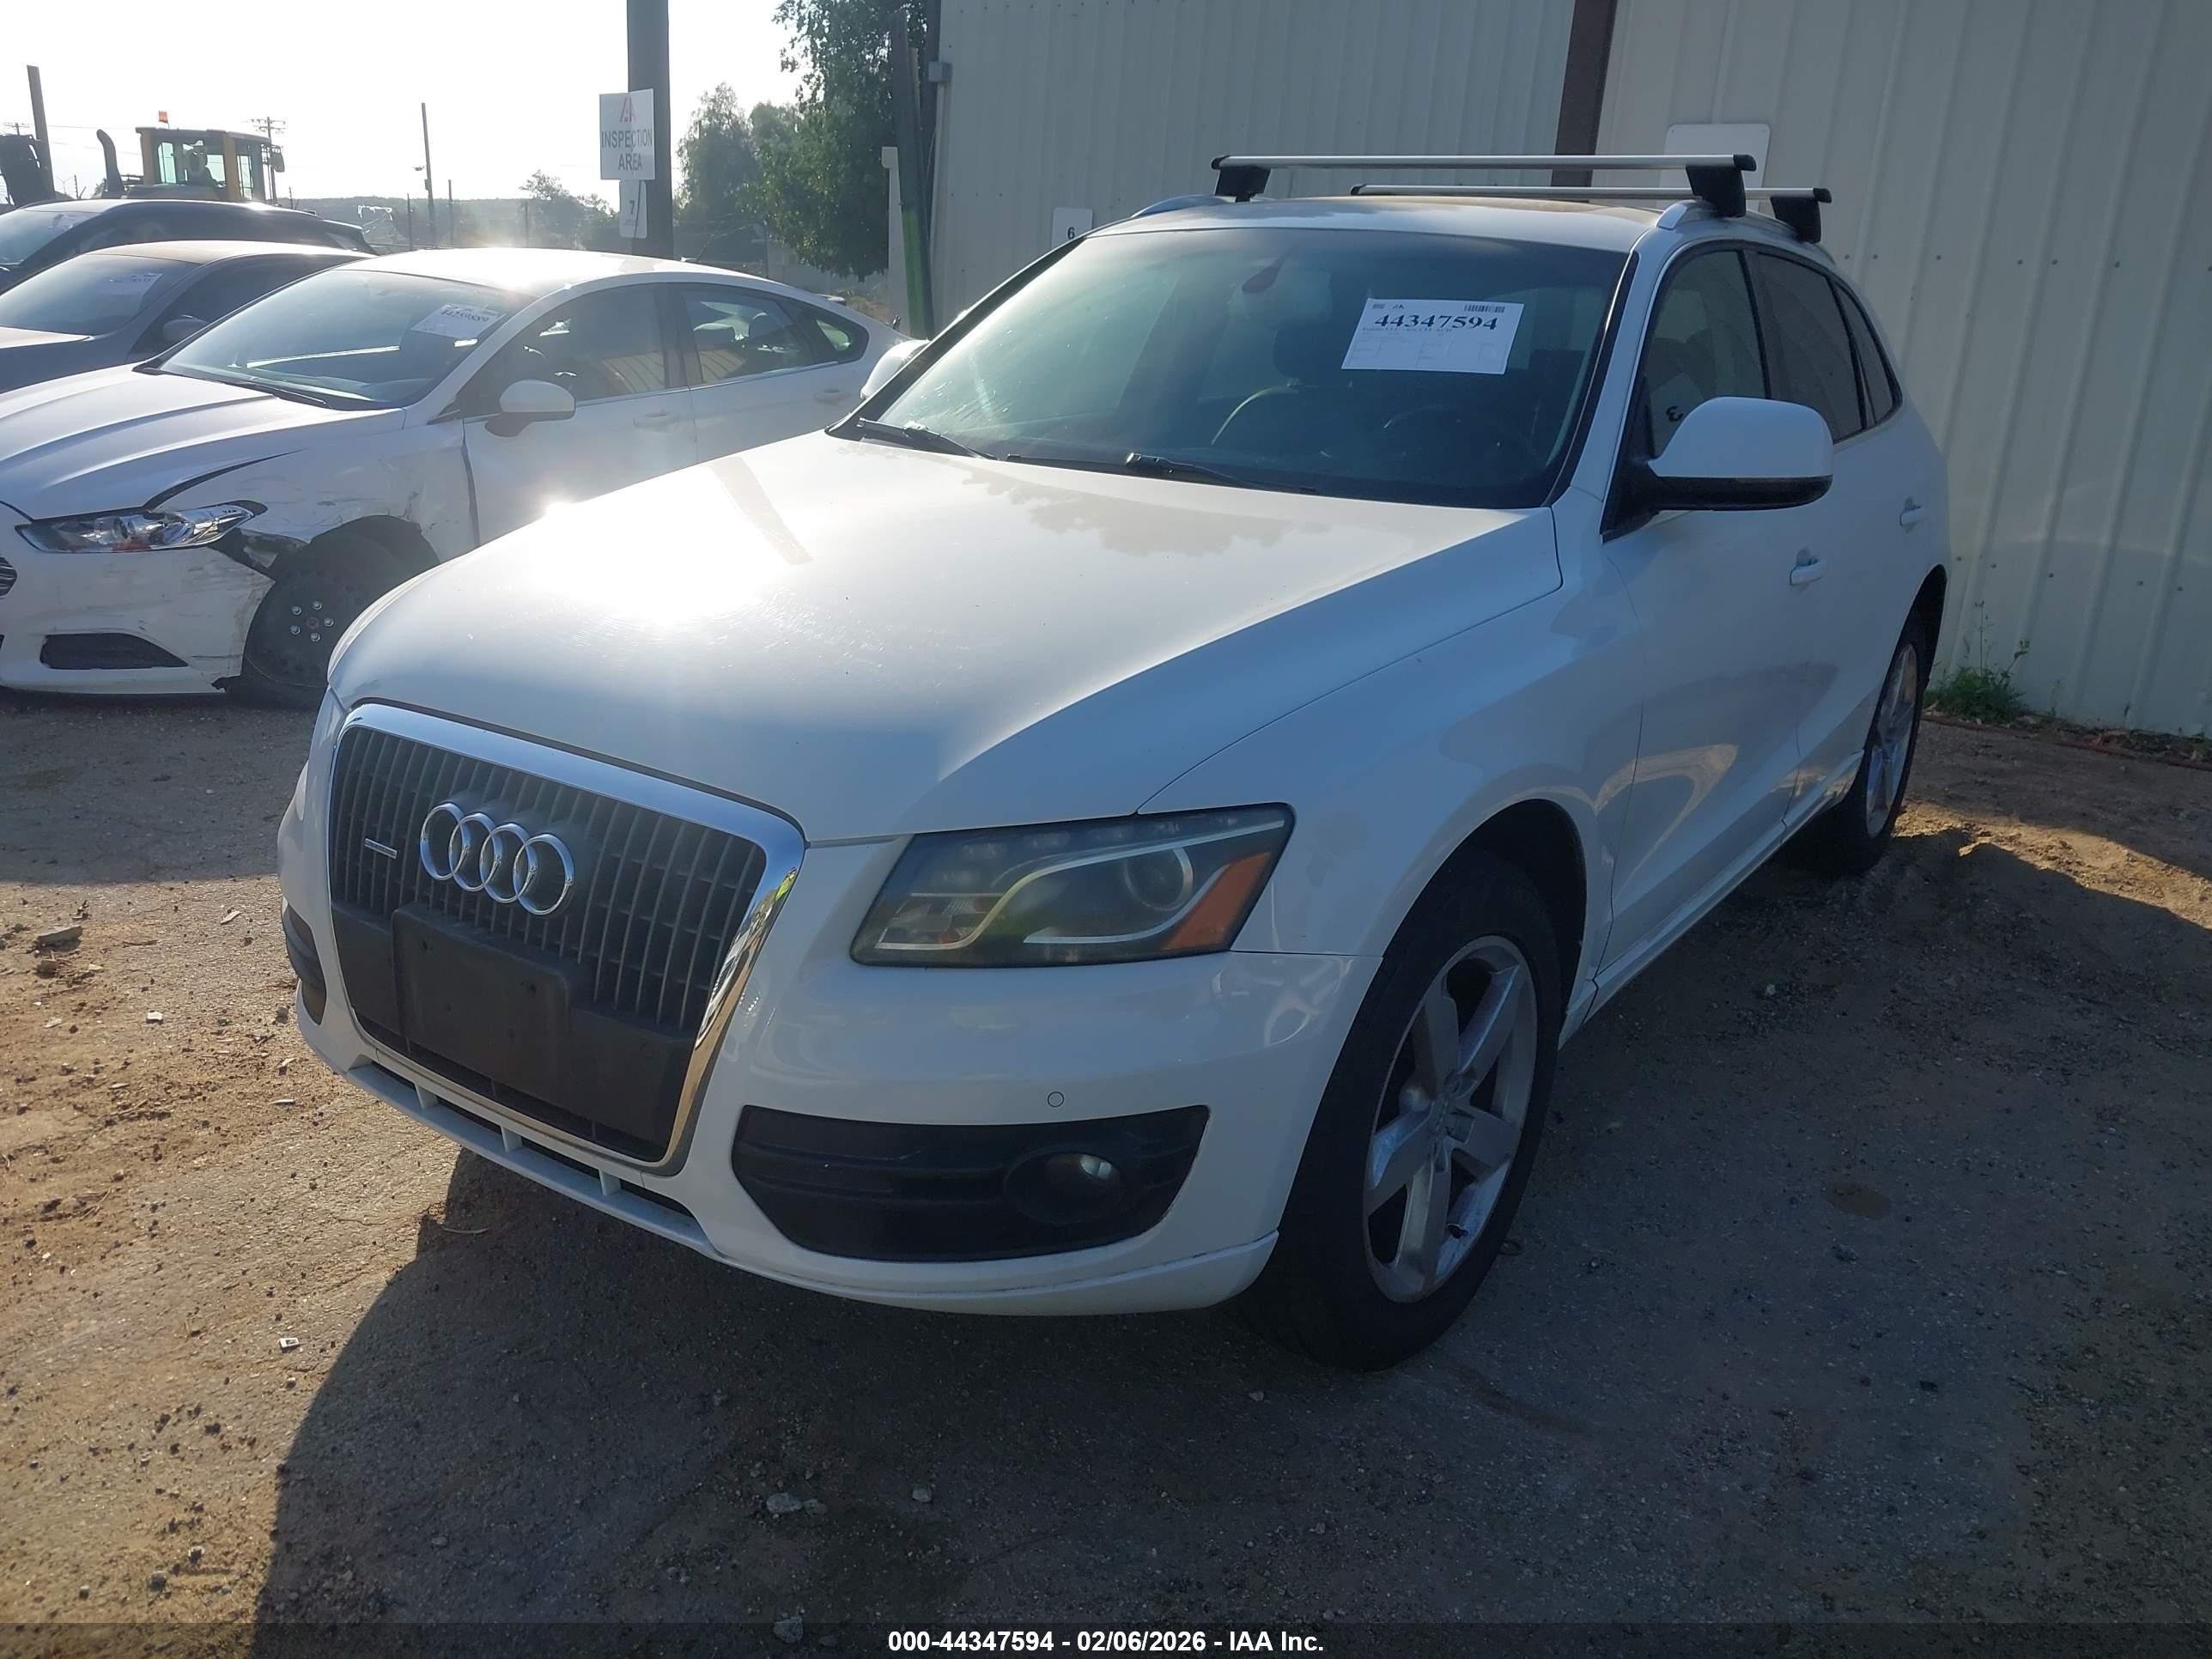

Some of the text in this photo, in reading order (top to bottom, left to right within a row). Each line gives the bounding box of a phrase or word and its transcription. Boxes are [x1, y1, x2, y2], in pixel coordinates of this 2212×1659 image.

[601, 129, 653, 149] INSPECTION
[618, 153, 643, 172] AREA
[629, 199, 635, 215] 7
[1067, 226, 1075, 240] 6
[1375, 314, 1498, 330] 44347594
